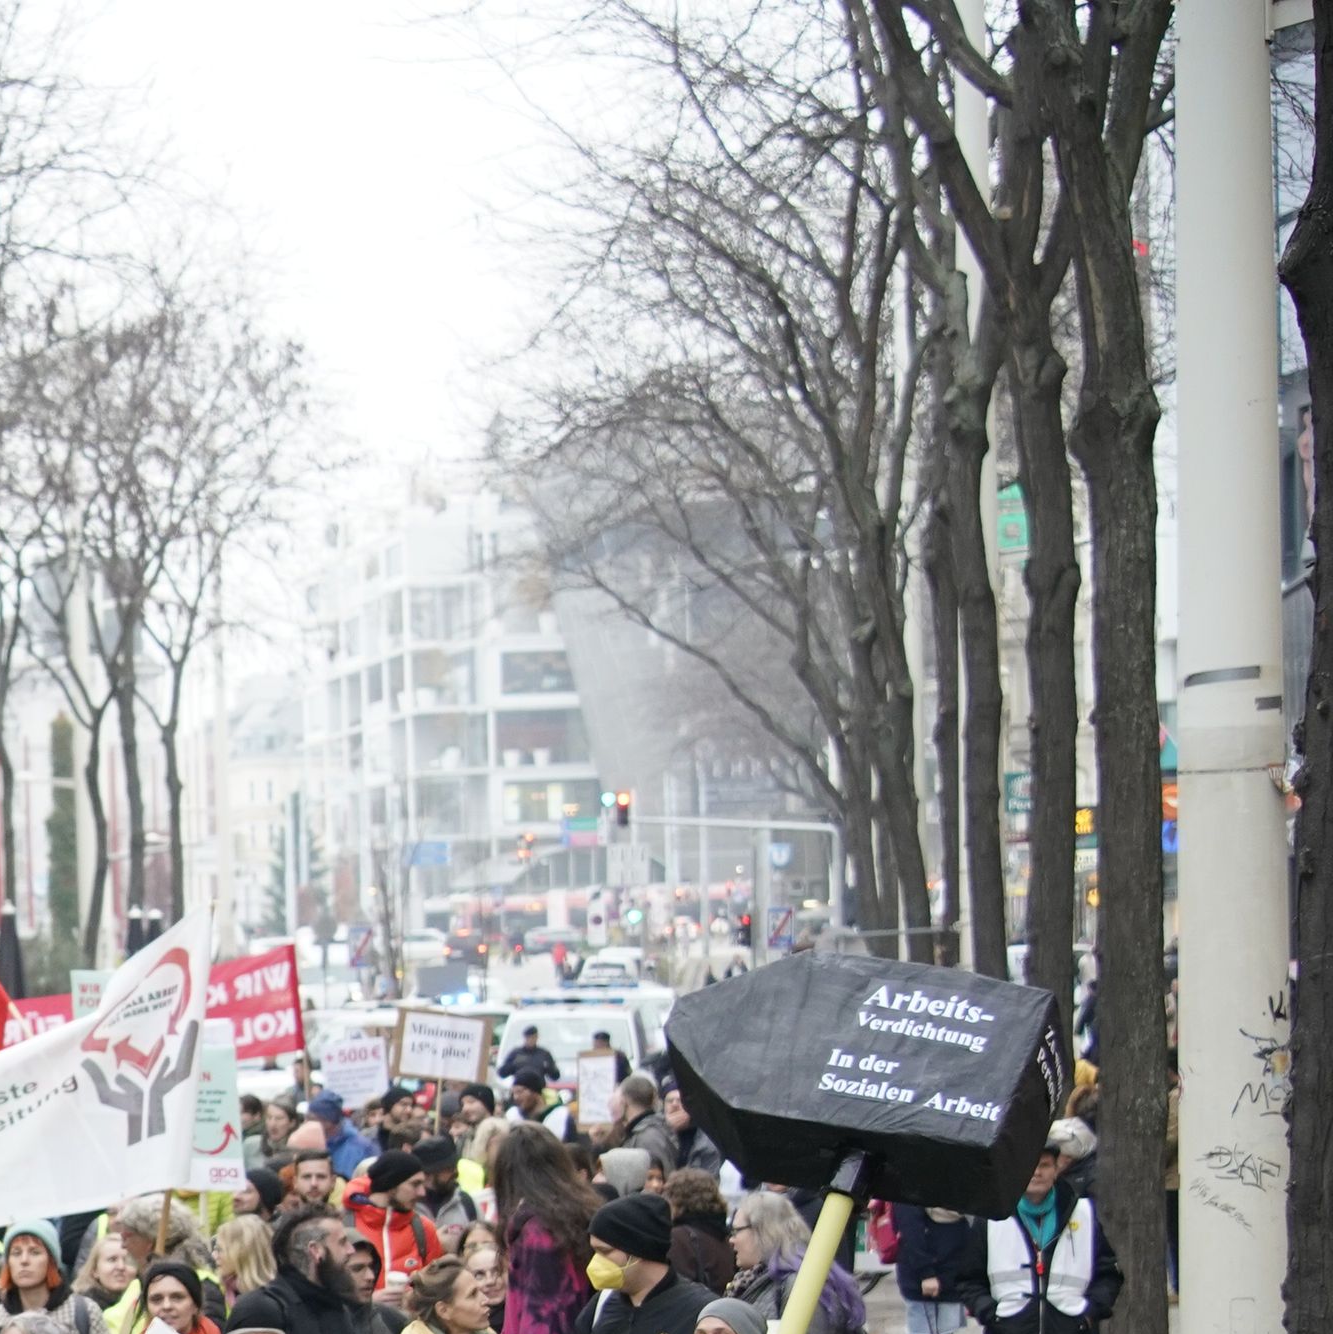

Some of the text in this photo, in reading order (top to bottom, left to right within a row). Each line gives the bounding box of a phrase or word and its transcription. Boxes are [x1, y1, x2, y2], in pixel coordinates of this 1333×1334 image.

[863, 984, 995, 1024] Arbeits-
[410, 1042, 437, 1055] 15%
[411, 1023, 474, 1041] Minimum:
[858, 1011, 987, 1053] Verdichtung
[828, 1049, 899, 1075] In der
[818, 1072, 1002, 1122] Sozialen Arbeit
